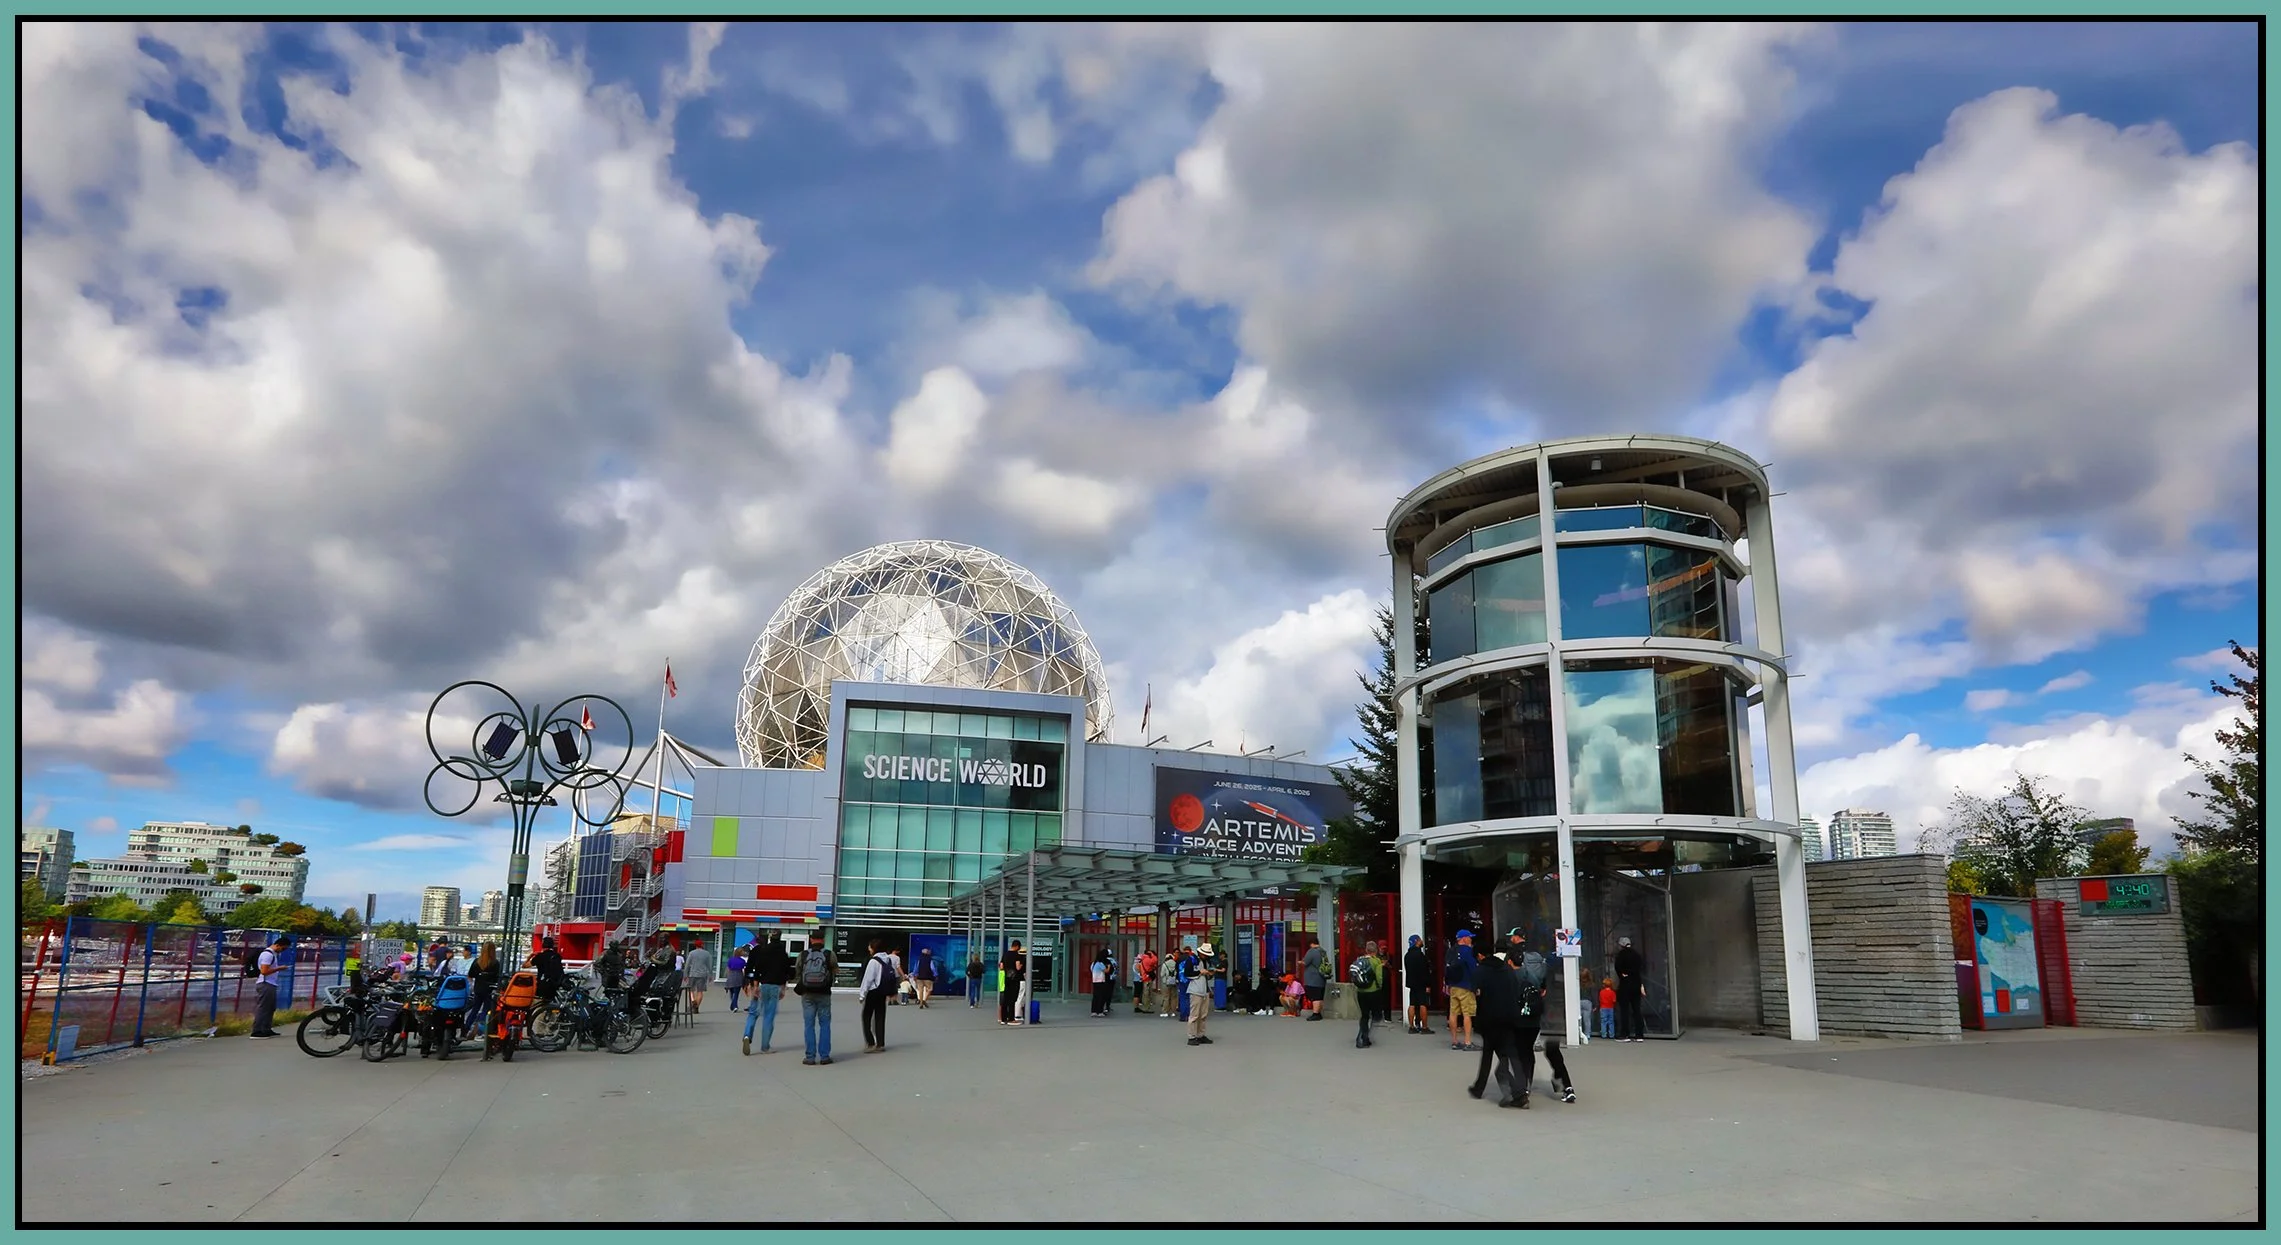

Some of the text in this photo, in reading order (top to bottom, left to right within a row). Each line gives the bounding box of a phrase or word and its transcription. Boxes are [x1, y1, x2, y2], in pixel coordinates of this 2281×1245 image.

[862, 754, 952, 783] SCIENCE
[1244, 783, 1263, 791] 2025
[1267, 786, 1286, 794] APRIL
[1203, 817, 1316, 843] ARTEMIS
[1182, 836, 1237, 851] SPACE
[1241, 840, 1307, 856] ADVENT
